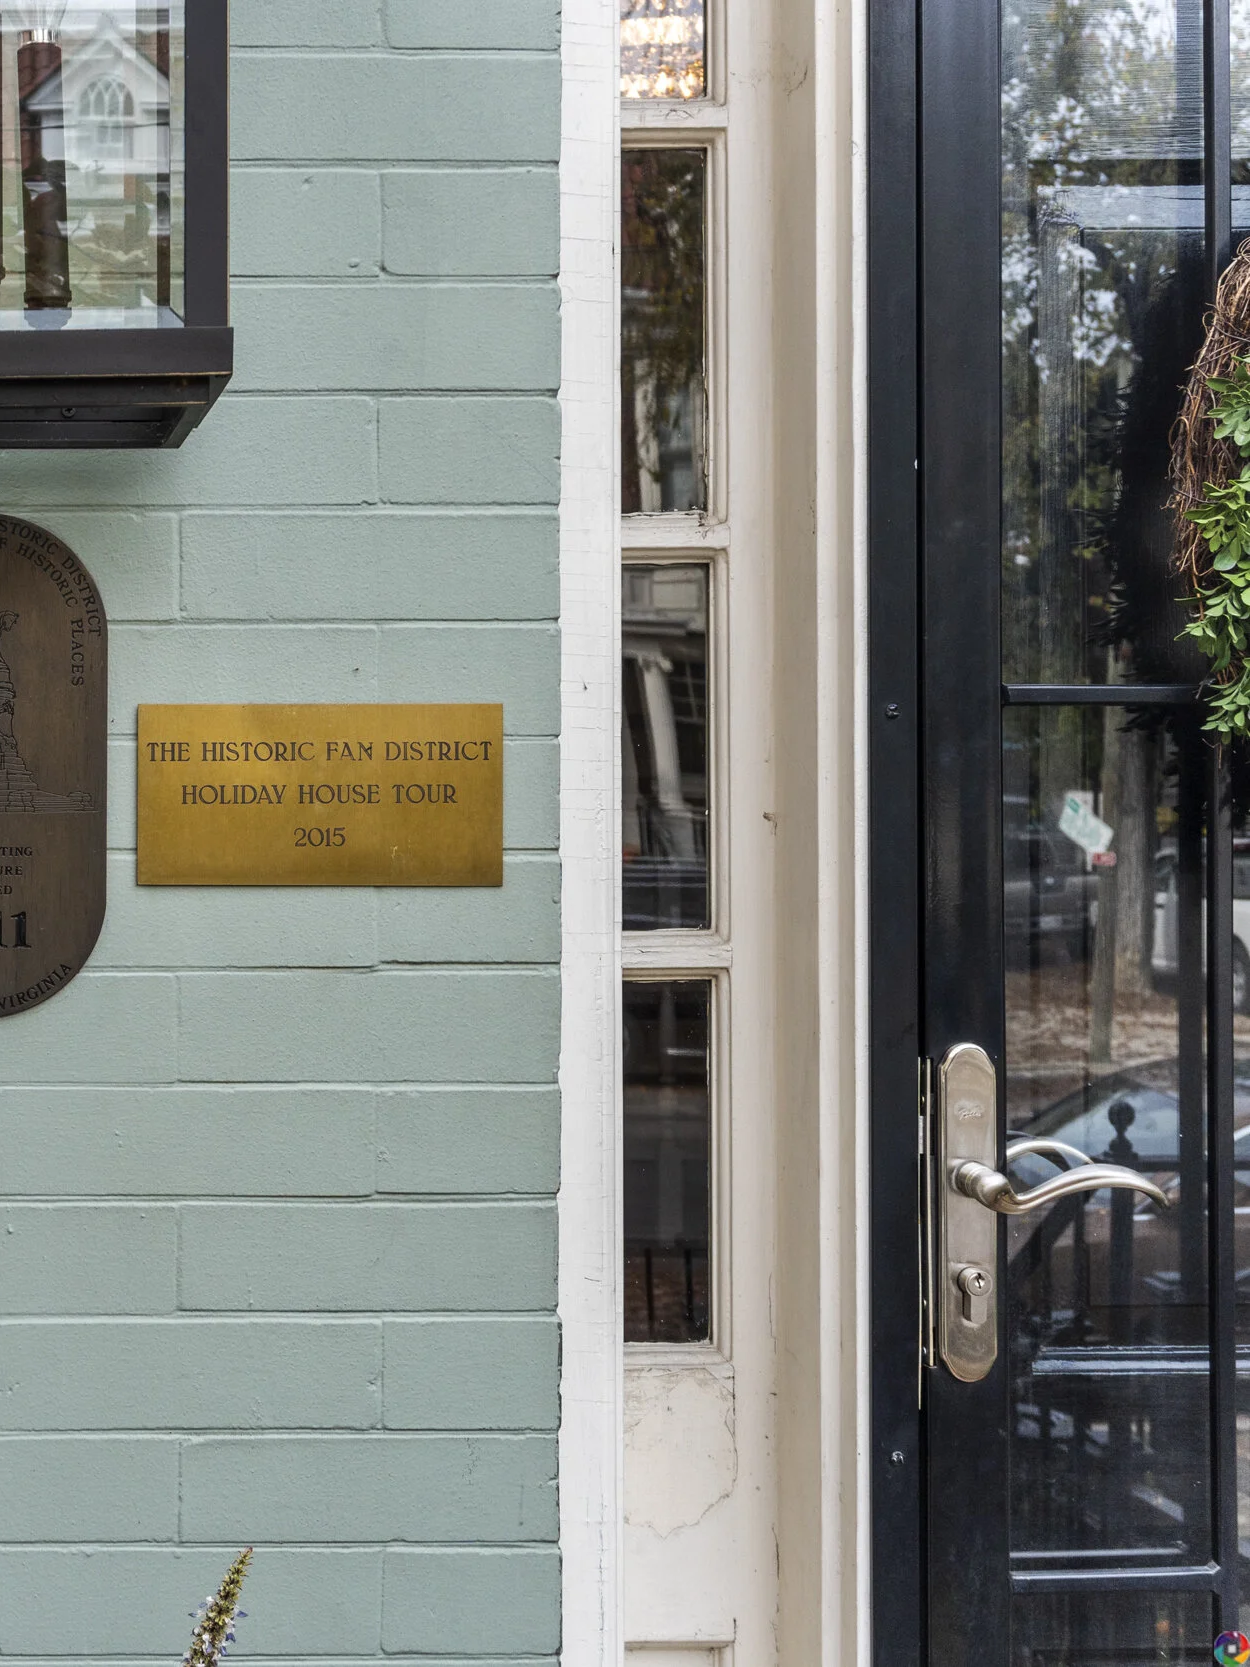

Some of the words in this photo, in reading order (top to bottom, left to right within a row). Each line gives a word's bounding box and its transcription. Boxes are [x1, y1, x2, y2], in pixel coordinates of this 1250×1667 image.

[61, 555, 101, 637] DISTRICT
[16, 543, 79, 608] HISTORIC
[70, 618, 84, 687] PLACES
[147, 742, 190, 762] THE
[201, 742, 316, 762] HISTORIC
[325, 742, 374, 762] FAN
[384, 741, 492, 761] DISTRICT
[181, 784, 287, 805] HOLIDAY
[298, 784, 381, 804] HOUSE
[392, 784, 458, 804] TOUR
[293, 827, 346, 848] 2015
